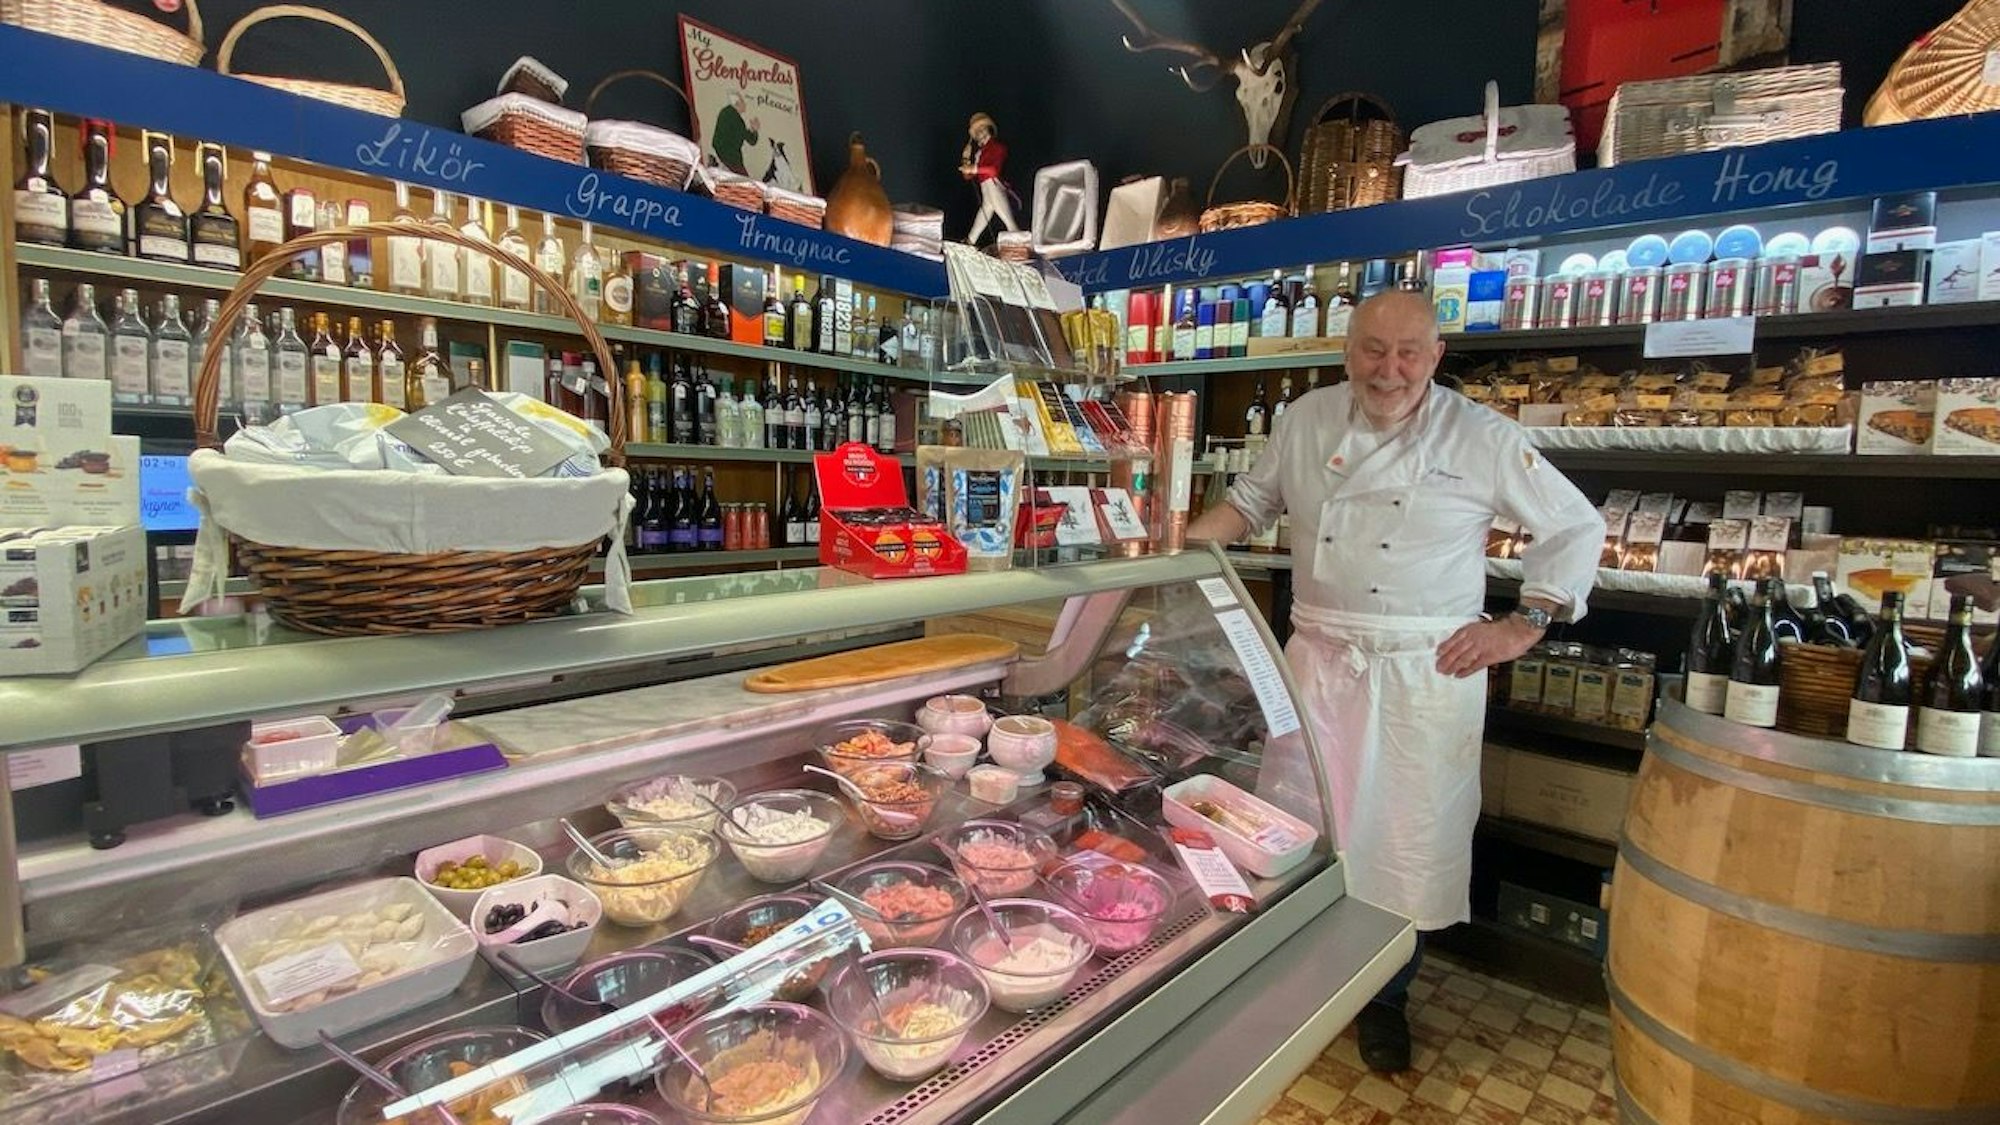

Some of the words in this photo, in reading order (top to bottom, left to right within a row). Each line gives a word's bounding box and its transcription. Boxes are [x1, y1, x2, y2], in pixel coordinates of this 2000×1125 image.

[688, 27, 712, 47] My
[692, 46, 794, 90] Glenfarclas
[356, 122, 485, 182] Likör
[566, 172, 683, 229] Grappa
[1460, 173, 1685, 238] Schokolade
[1712, 153, 1839, 203] Honig
[735, 213, 851, 265] Armagnac
[1128, 236, 1217, 280] Whisky
